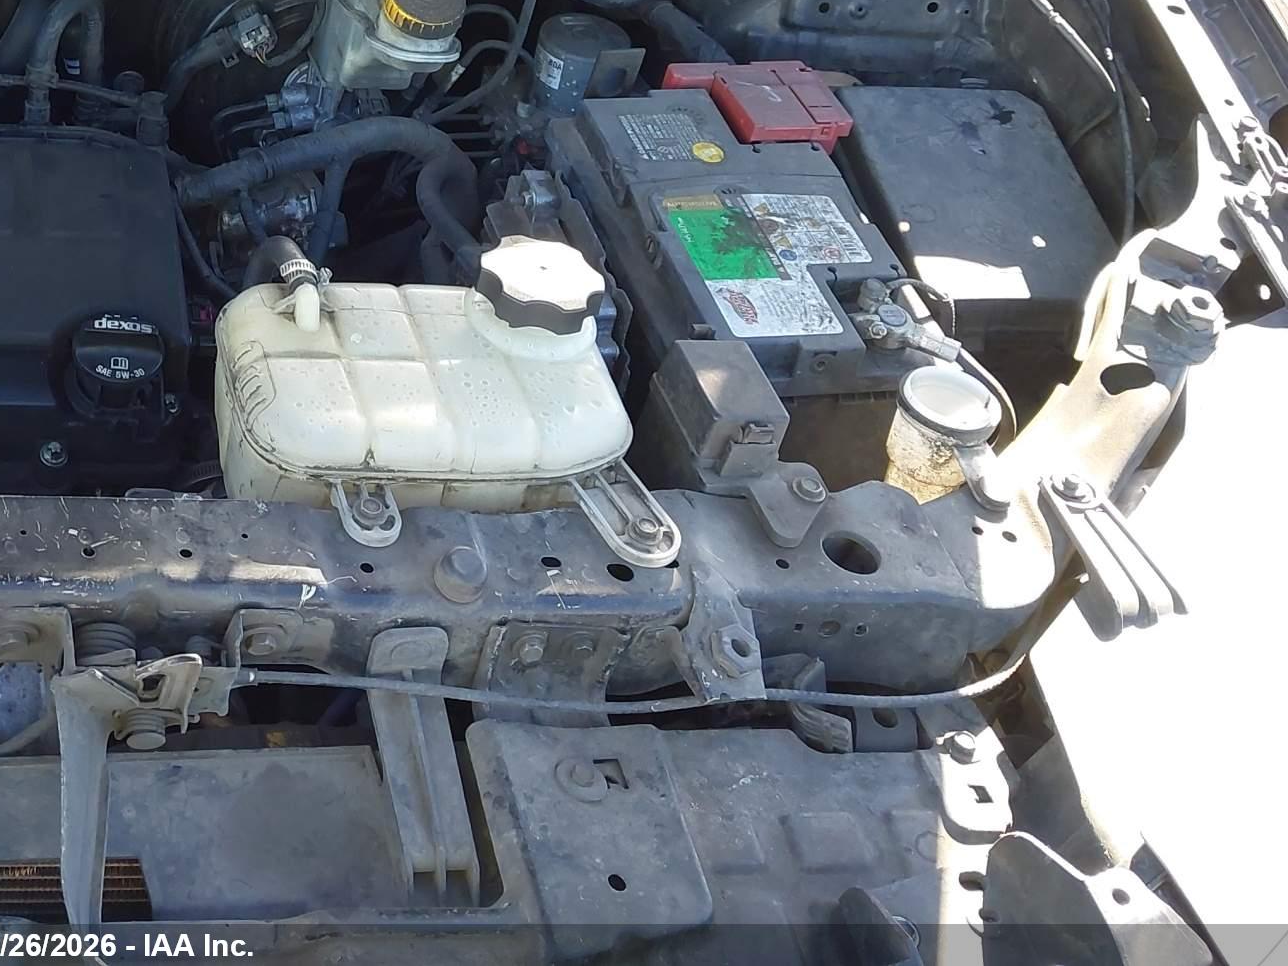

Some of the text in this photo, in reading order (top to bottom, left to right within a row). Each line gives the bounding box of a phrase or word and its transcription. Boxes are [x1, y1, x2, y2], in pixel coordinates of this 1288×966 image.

[94, 317, 153, 334] dexos
[95, 364, 145, 380] SAE 5W-30
